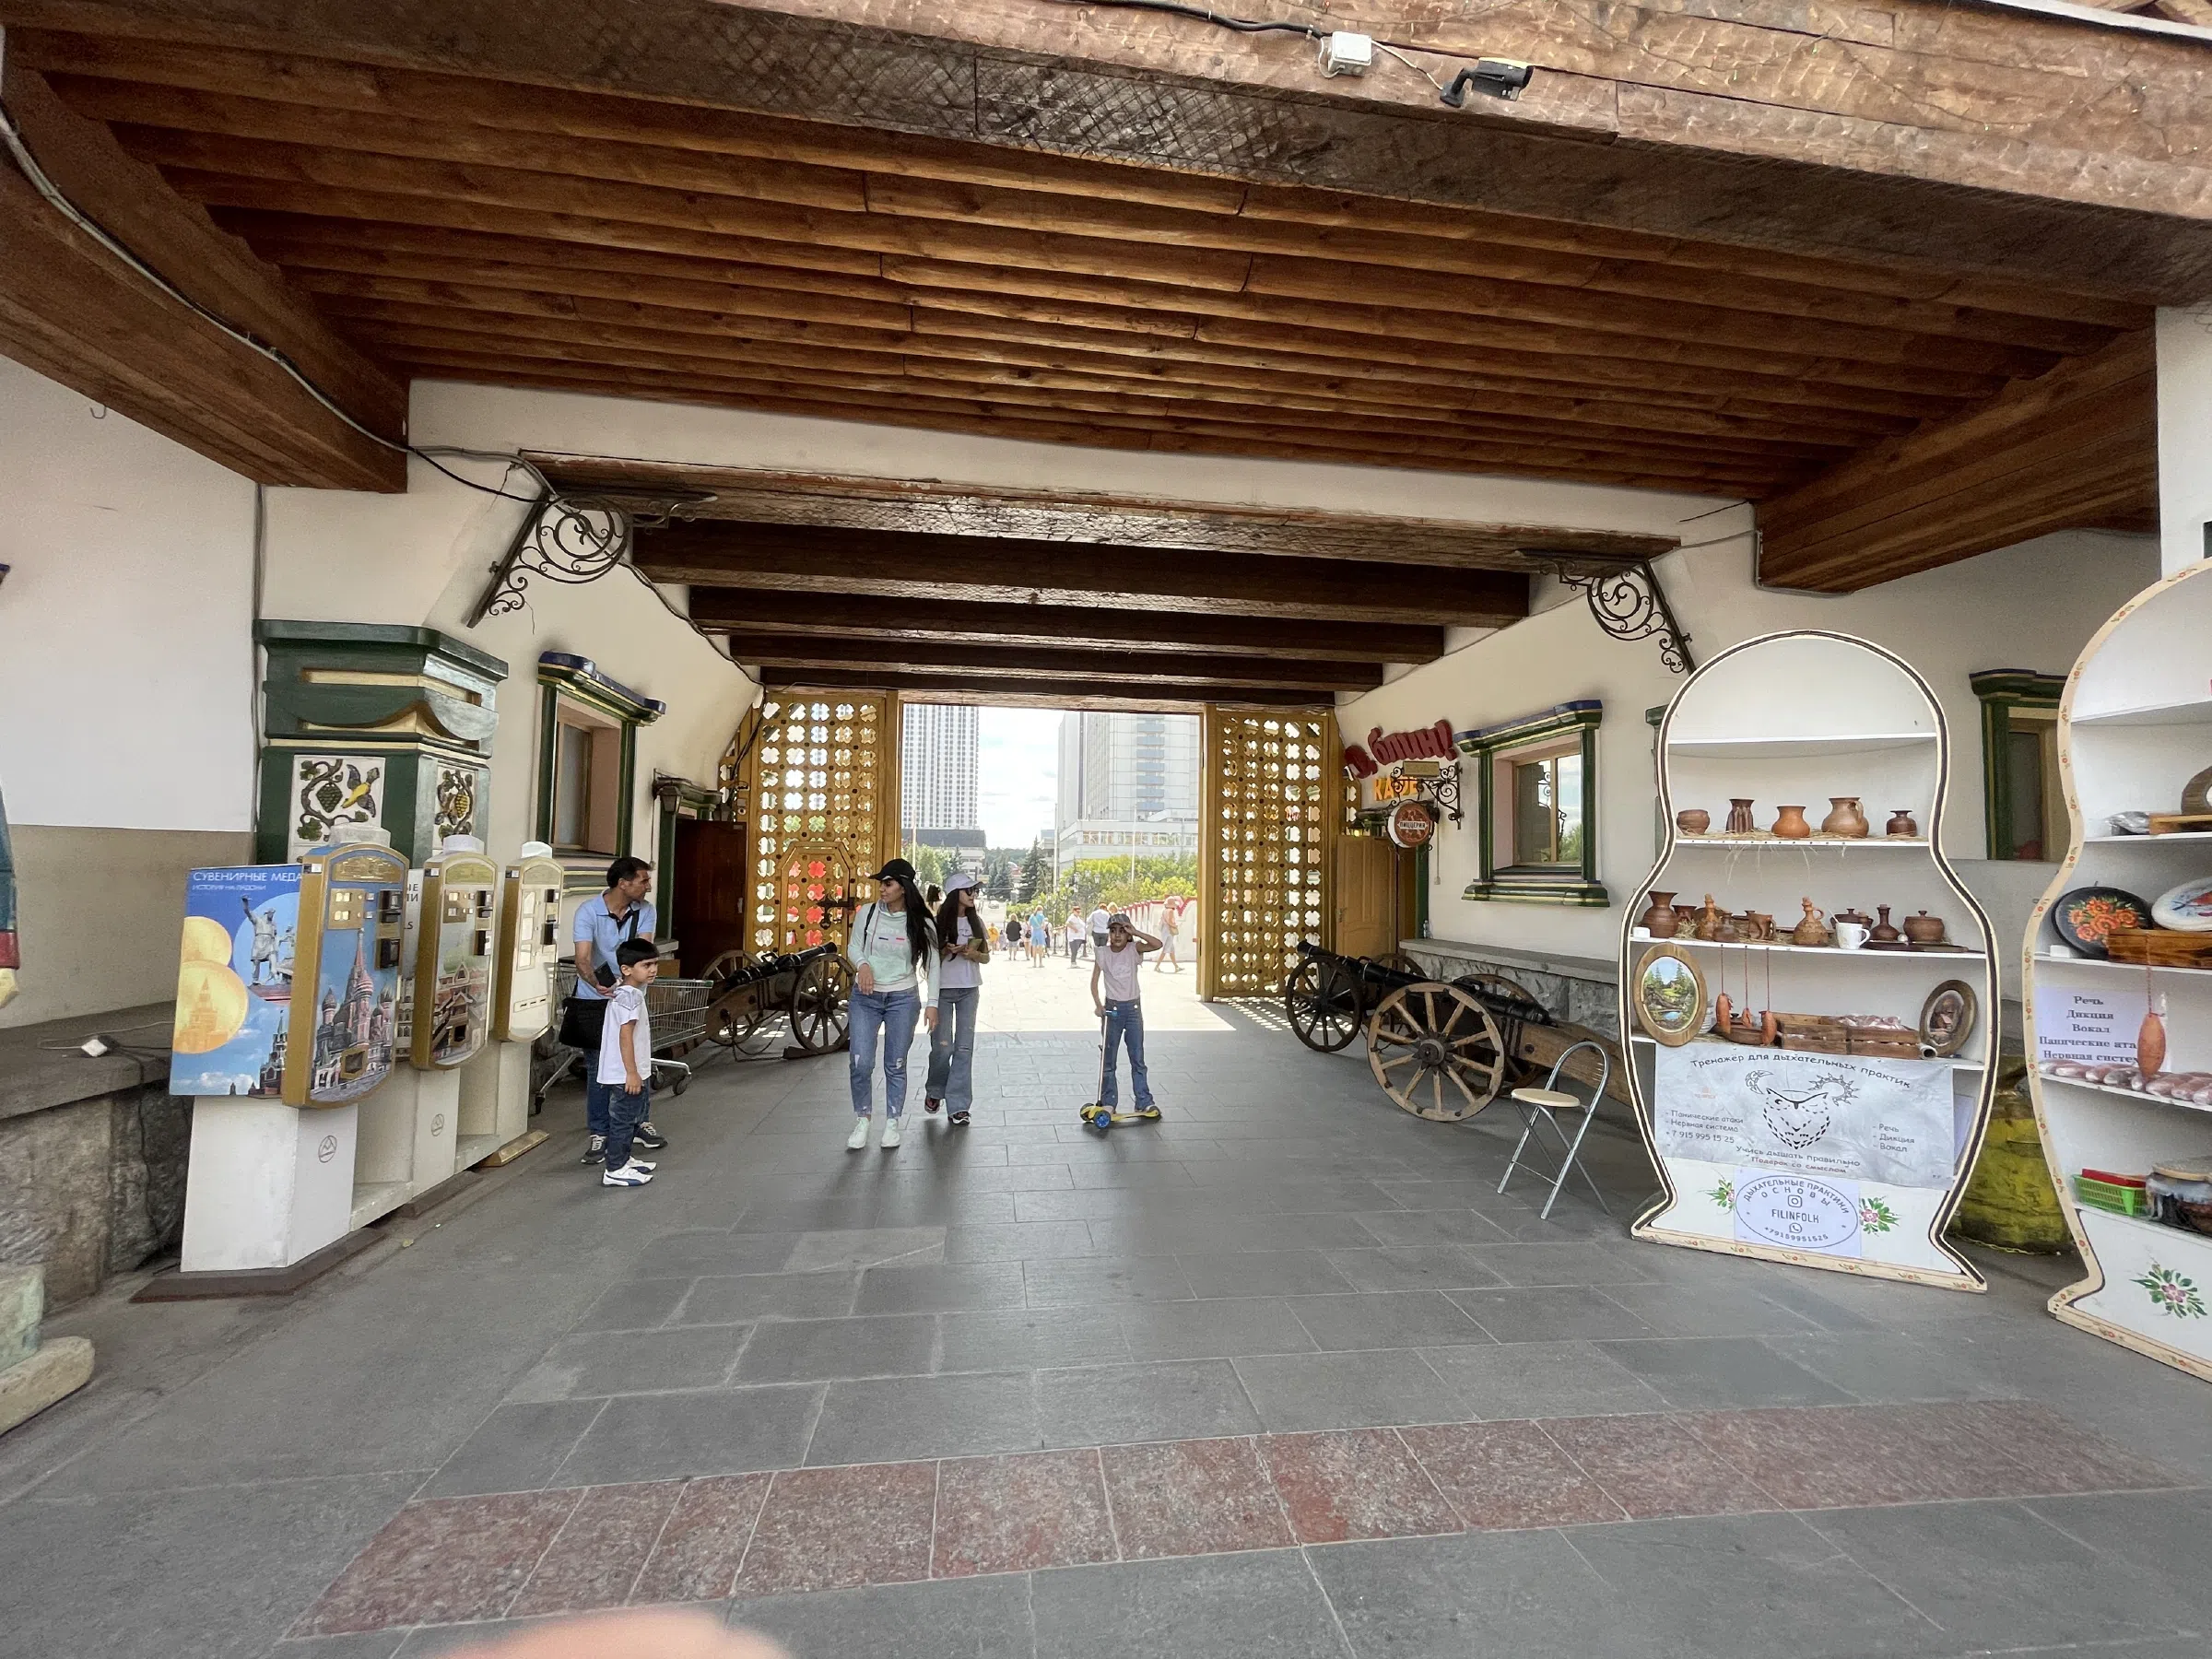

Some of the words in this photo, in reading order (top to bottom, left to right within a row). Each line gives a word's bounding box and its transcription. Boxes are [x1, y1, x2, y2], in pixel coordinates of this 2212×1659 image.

[1368, 720, 1457, 766] блин!
[1399, 821, 1426, 830] ПИЦЦЕРИЯ
[193, 872, 268, 882] СУВЕНИРНЫЕ
[2074, 995, 2104, 1006] Речь
[2066, 1009, 2114, 1020] Дикция
[2072, 1023, 2111, 1033] Вокал
[2039, 1036, 2111, 1047] Панические
[2043, 1050, 2093, 1061] Нервная
[1772, 1054, 1856, 1071] дыхательных
[1860, 1067, 1911, 1088] практик
[1671, 1109, 1720, 1122] Панические
[1670, 1118, 1703, 1128] Нервная
[1705, 1124, 1739, 1133] система
[1878, 1123, 1900, 1133] Речь
[1678, 1131, 1694, 1139] 915
[1695, 1132, 1711, 1141] 995
[1724, 1135, 1735, 1144] 25
[1878, 1133, 1915, 1144] Дикция
[1879, 1142, 1908, 1153] Вокал
[1735, 1145, 1764, 1155] Учись
[1766, 1149, 1804, 1159] дышать
[1806, 1155, 1861, 1167] правильно
[1750, 1156, 1788, 1166] Подарок
[1805, 1165, 1847, 1173] смыслом
[1743, 1179, 1805, 1202] ДЫХАТЕЛЬНЫЕ
[1806, 1182, 1850, 1214] ПРАКТИКИ
[1771, 1208, 1819, 1224] FILINFOLK
